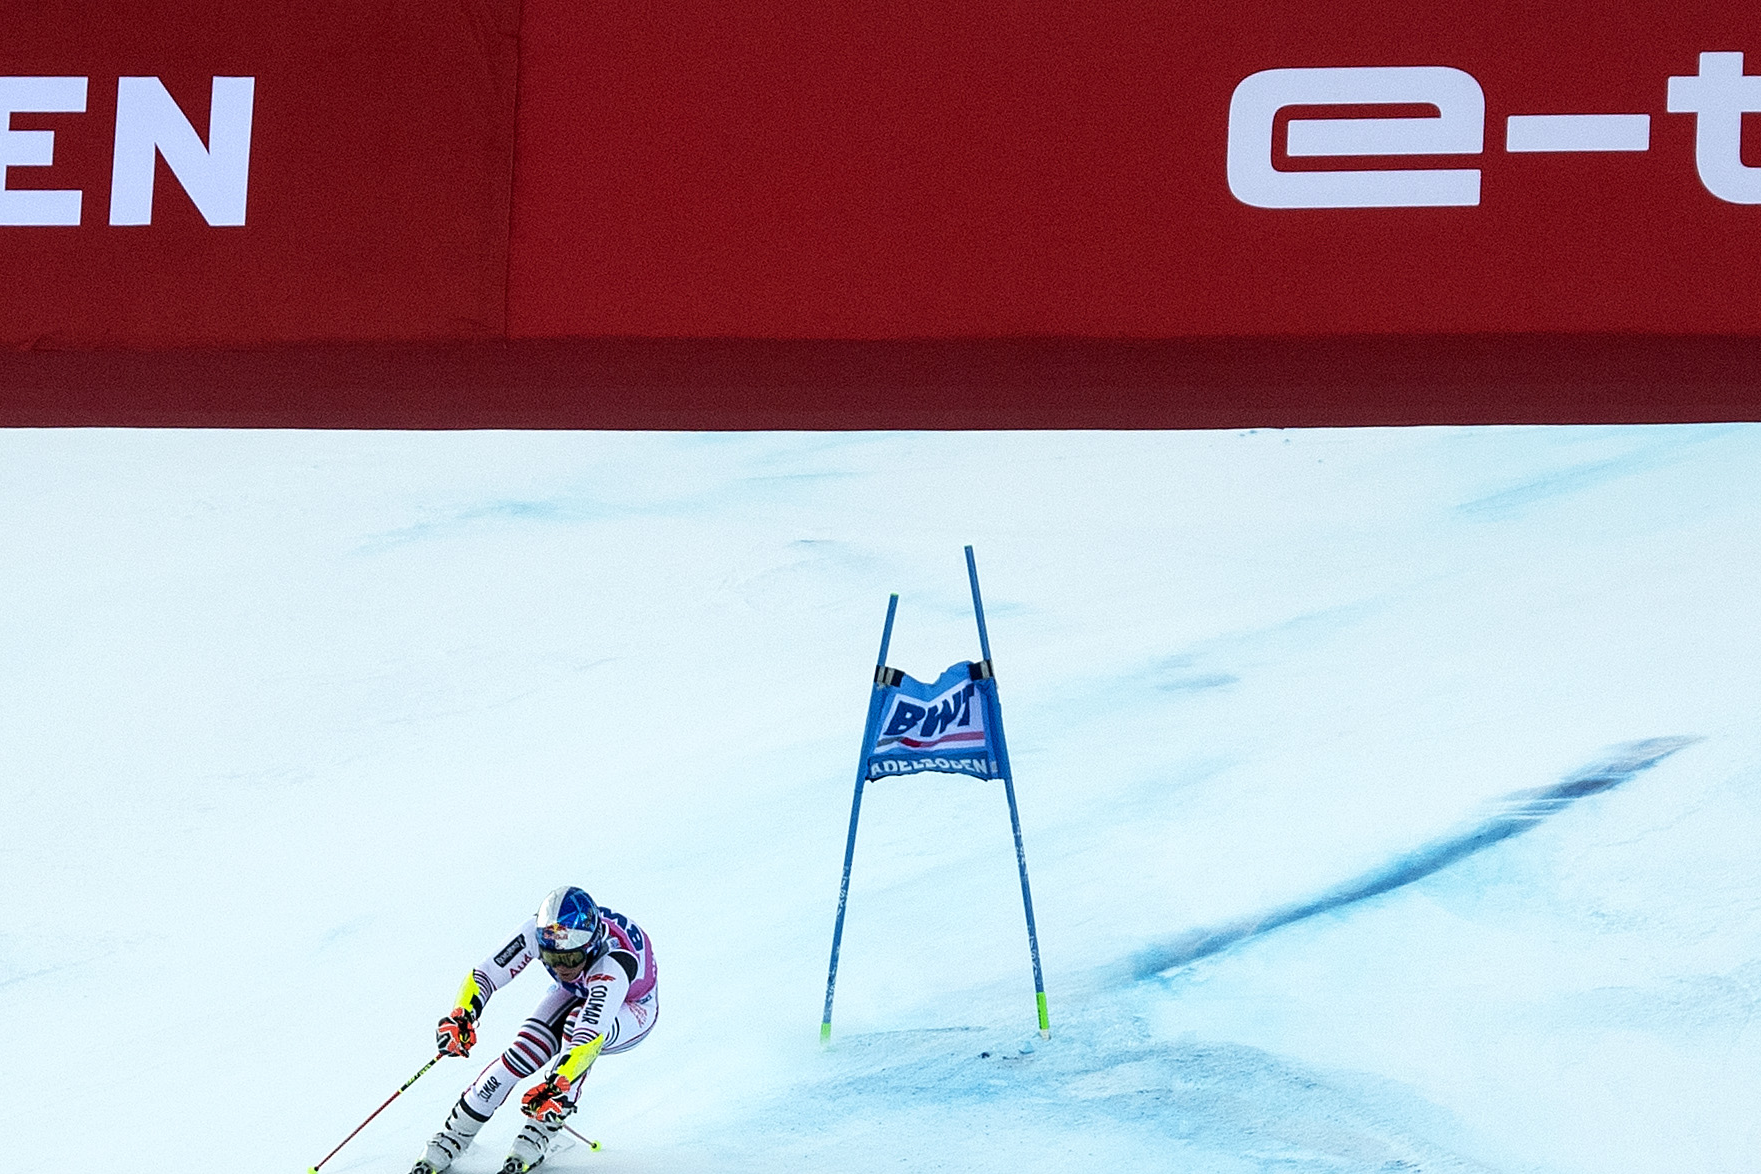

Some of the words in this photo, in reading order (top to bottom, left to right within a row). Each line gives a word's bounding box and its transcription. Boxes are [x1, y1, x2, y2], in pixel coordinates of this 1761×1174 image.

[1227, 51, 1761, 209] e-t
[883, 683, 975, 737] BWT
[871, 758, 987, 776] ADELBODEN
[581, 985, 608, 1025] COLMAR
